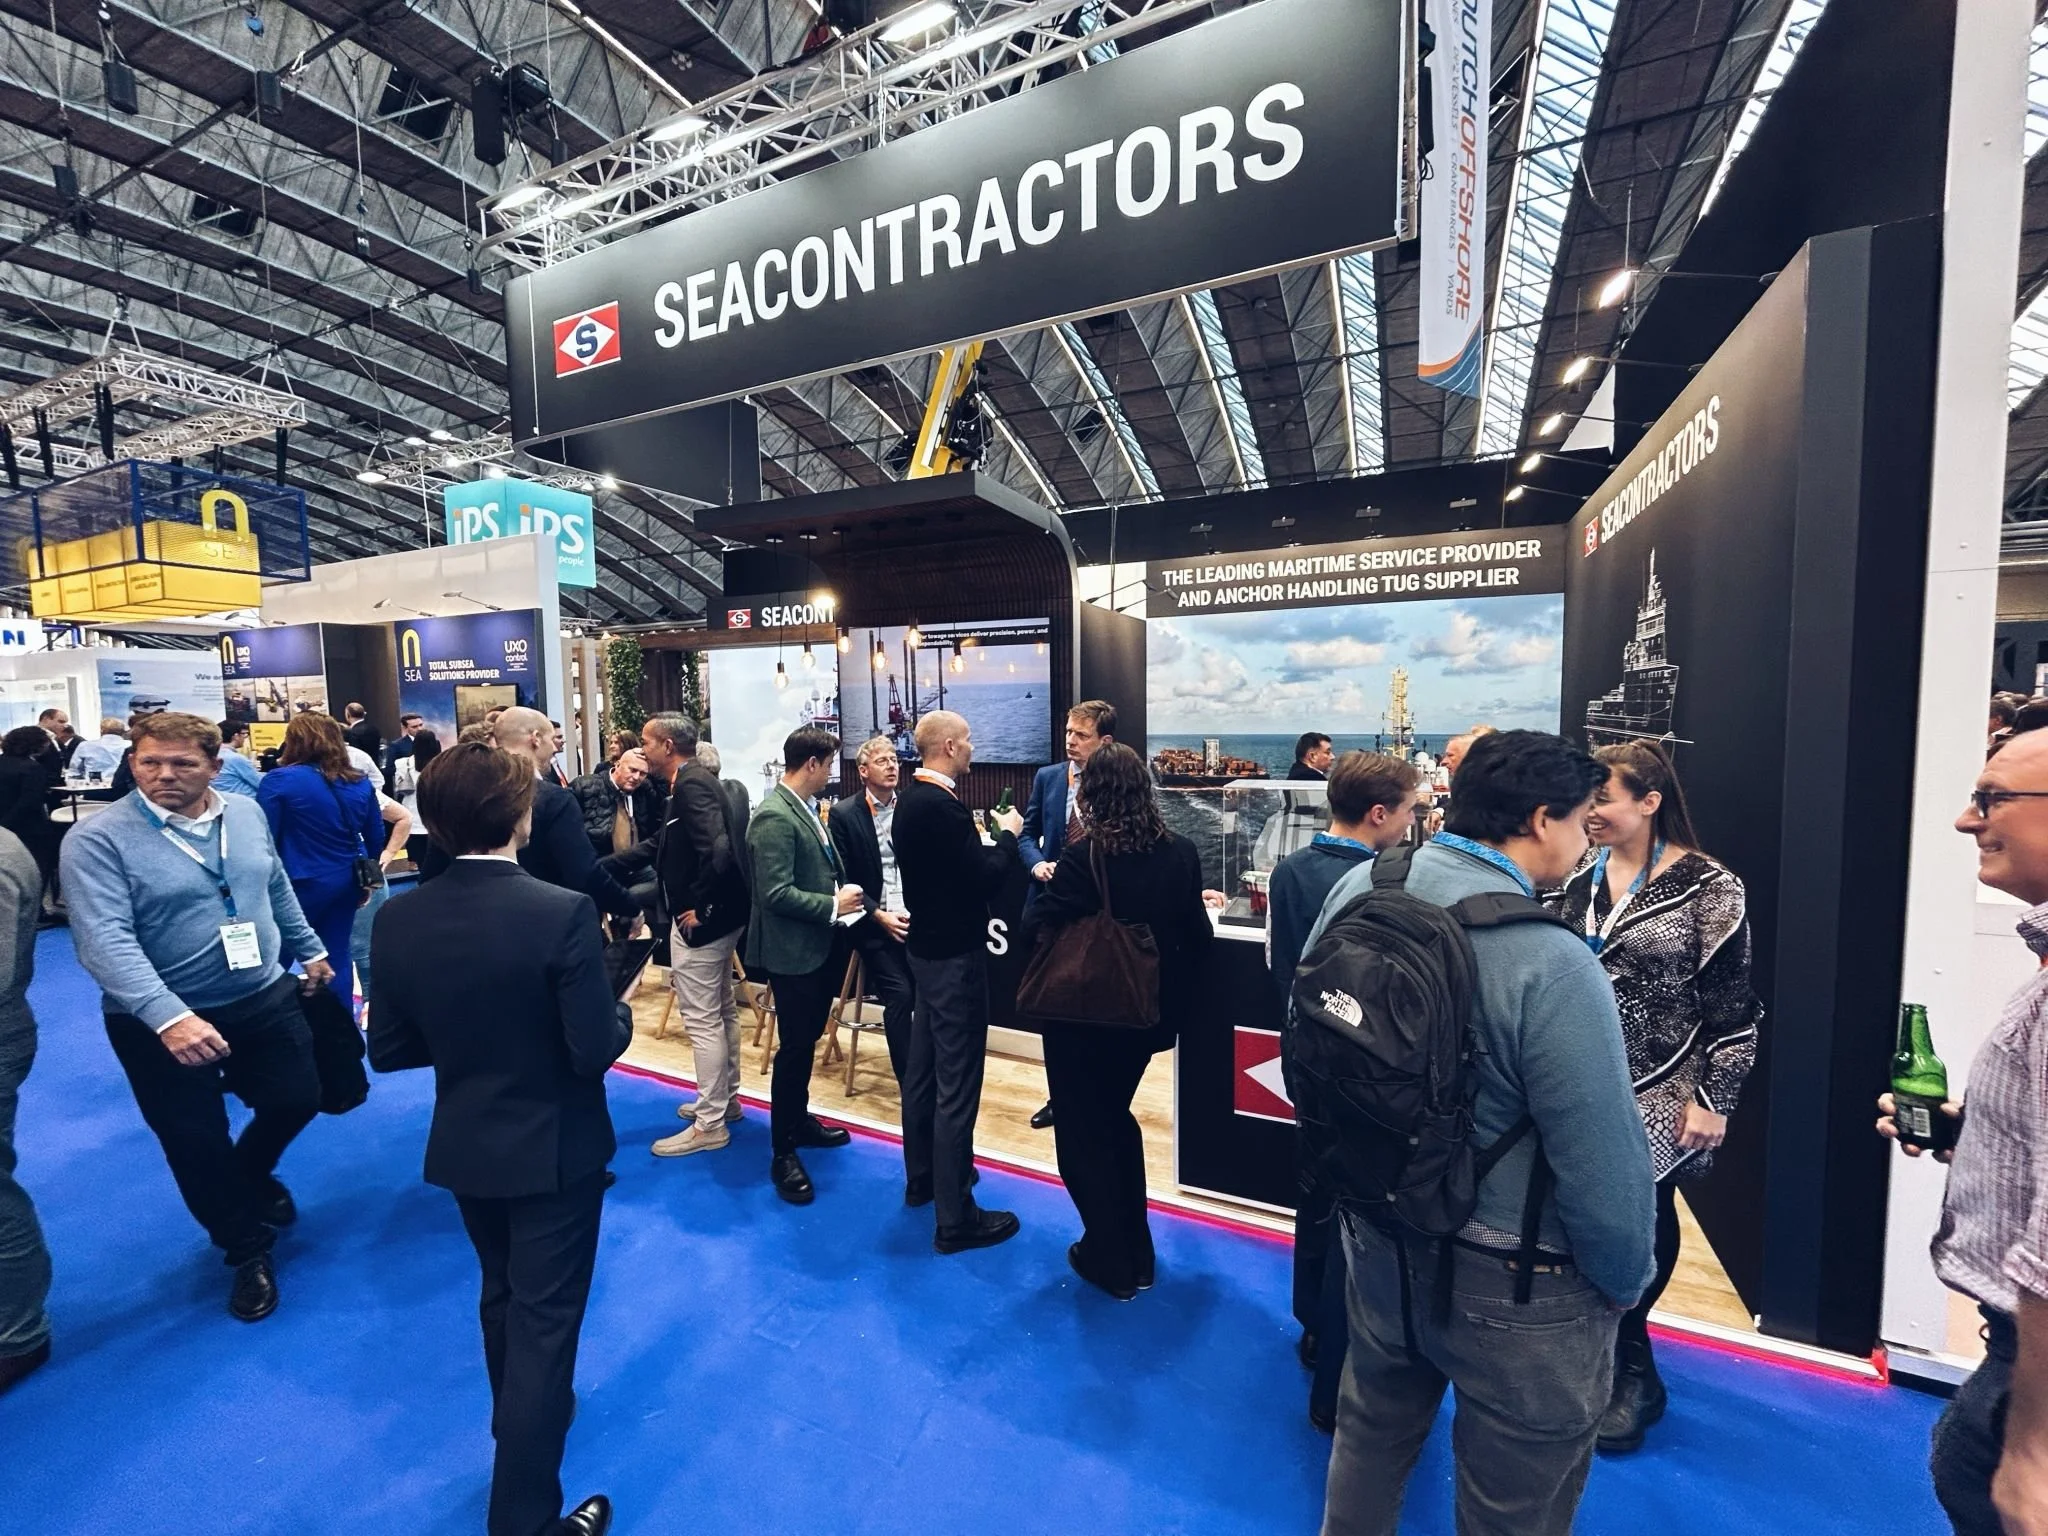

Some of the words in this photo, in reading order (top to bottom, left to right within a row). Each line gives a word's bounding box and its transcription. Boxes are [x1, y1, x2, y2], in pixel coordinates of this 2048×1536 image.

[576, 322, 598, 358] S
[654, 82, 1305, 349] SEACONTRACTORS
[1446, 274, 1455, 315] YARDS
[1601, 395, 1720, 543] SEACONTRACTORS
[558, 556, 584, 567] people
[1162, 569, 1193, 586] THE
[1196, 562, 1264, 584] LEADING
[1268, 554, 1356, 578] MARITIME
[1359, 547, 1437, 571] SERVICE
[1441, 540, 1541, 564] PROVIDER
[1177, 589, 1211, 608] AND
[1214, 586, 1283, 605] ANCHOR
[1287, 577, 1378, 600] HANDLING
[1381, 574, 1419, 593] TUG
[1424, 567, 1519, 590] SUPPLIER
[504, 639, 527, 653] UXO
[428, 661, 448, 671] TOTAL
[448, 659, 474, 669] SUBSEA
[405, 669, 422, 682] SEA
[429, 671, 465, 681] SOLUTIONS
[466, 669, 500, 679] PROVIDER
[986, 918, 1008, 955] S
[1320, 991, 1350, 1011] NORTH
[1335, 989, 1351, 1002] THE
[1324, 1002, 1346, 1018] FACE
